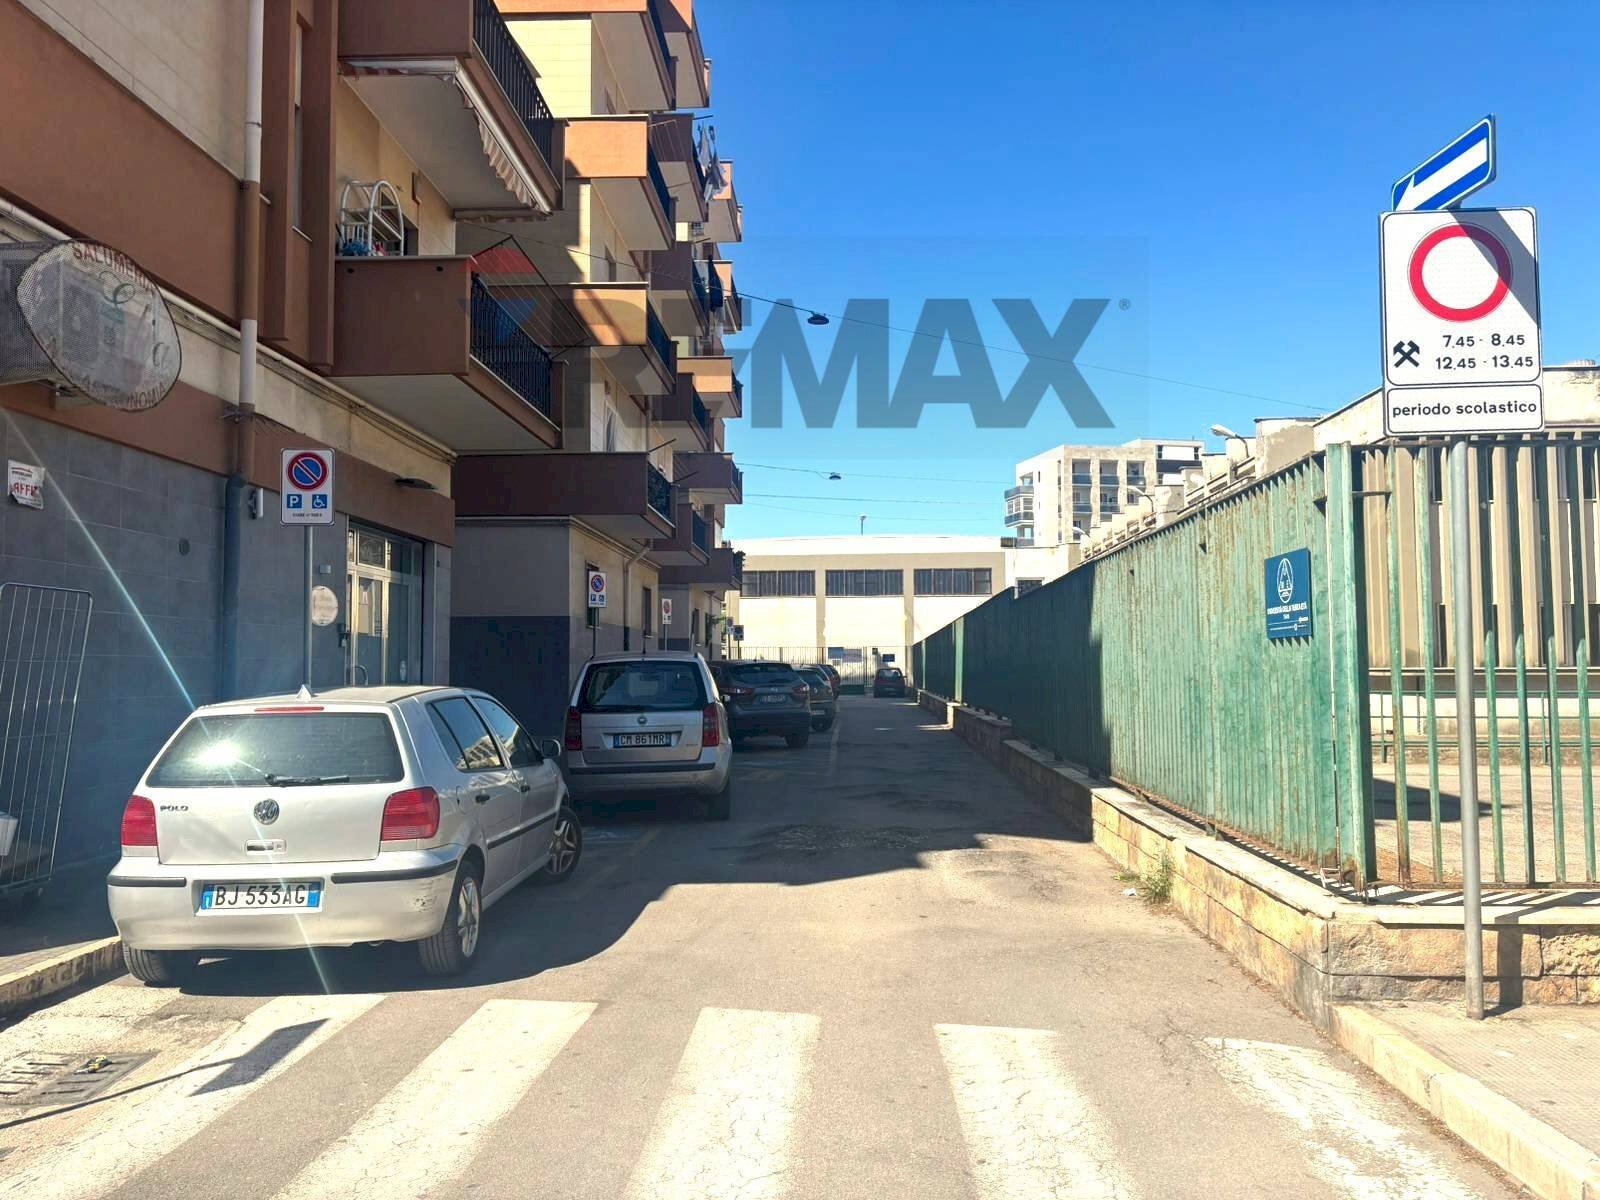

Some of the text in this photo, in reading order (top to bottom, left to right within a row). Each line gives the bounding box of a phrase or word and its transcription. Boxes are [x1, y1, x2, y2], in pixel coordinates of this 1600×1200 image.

[1442, 334, 1475, 349] 7.45
[1490, 333, 1525, 347] 8.45
[1435, 357, 1476, 371] 12.45
[1492, 354, 1534, 369] 13.45
[1393, 401, 1537, 418] periodo scolastico
[160, 804, 189, 812] POLO
[215, 884, 306, 906] BJ 533AG
